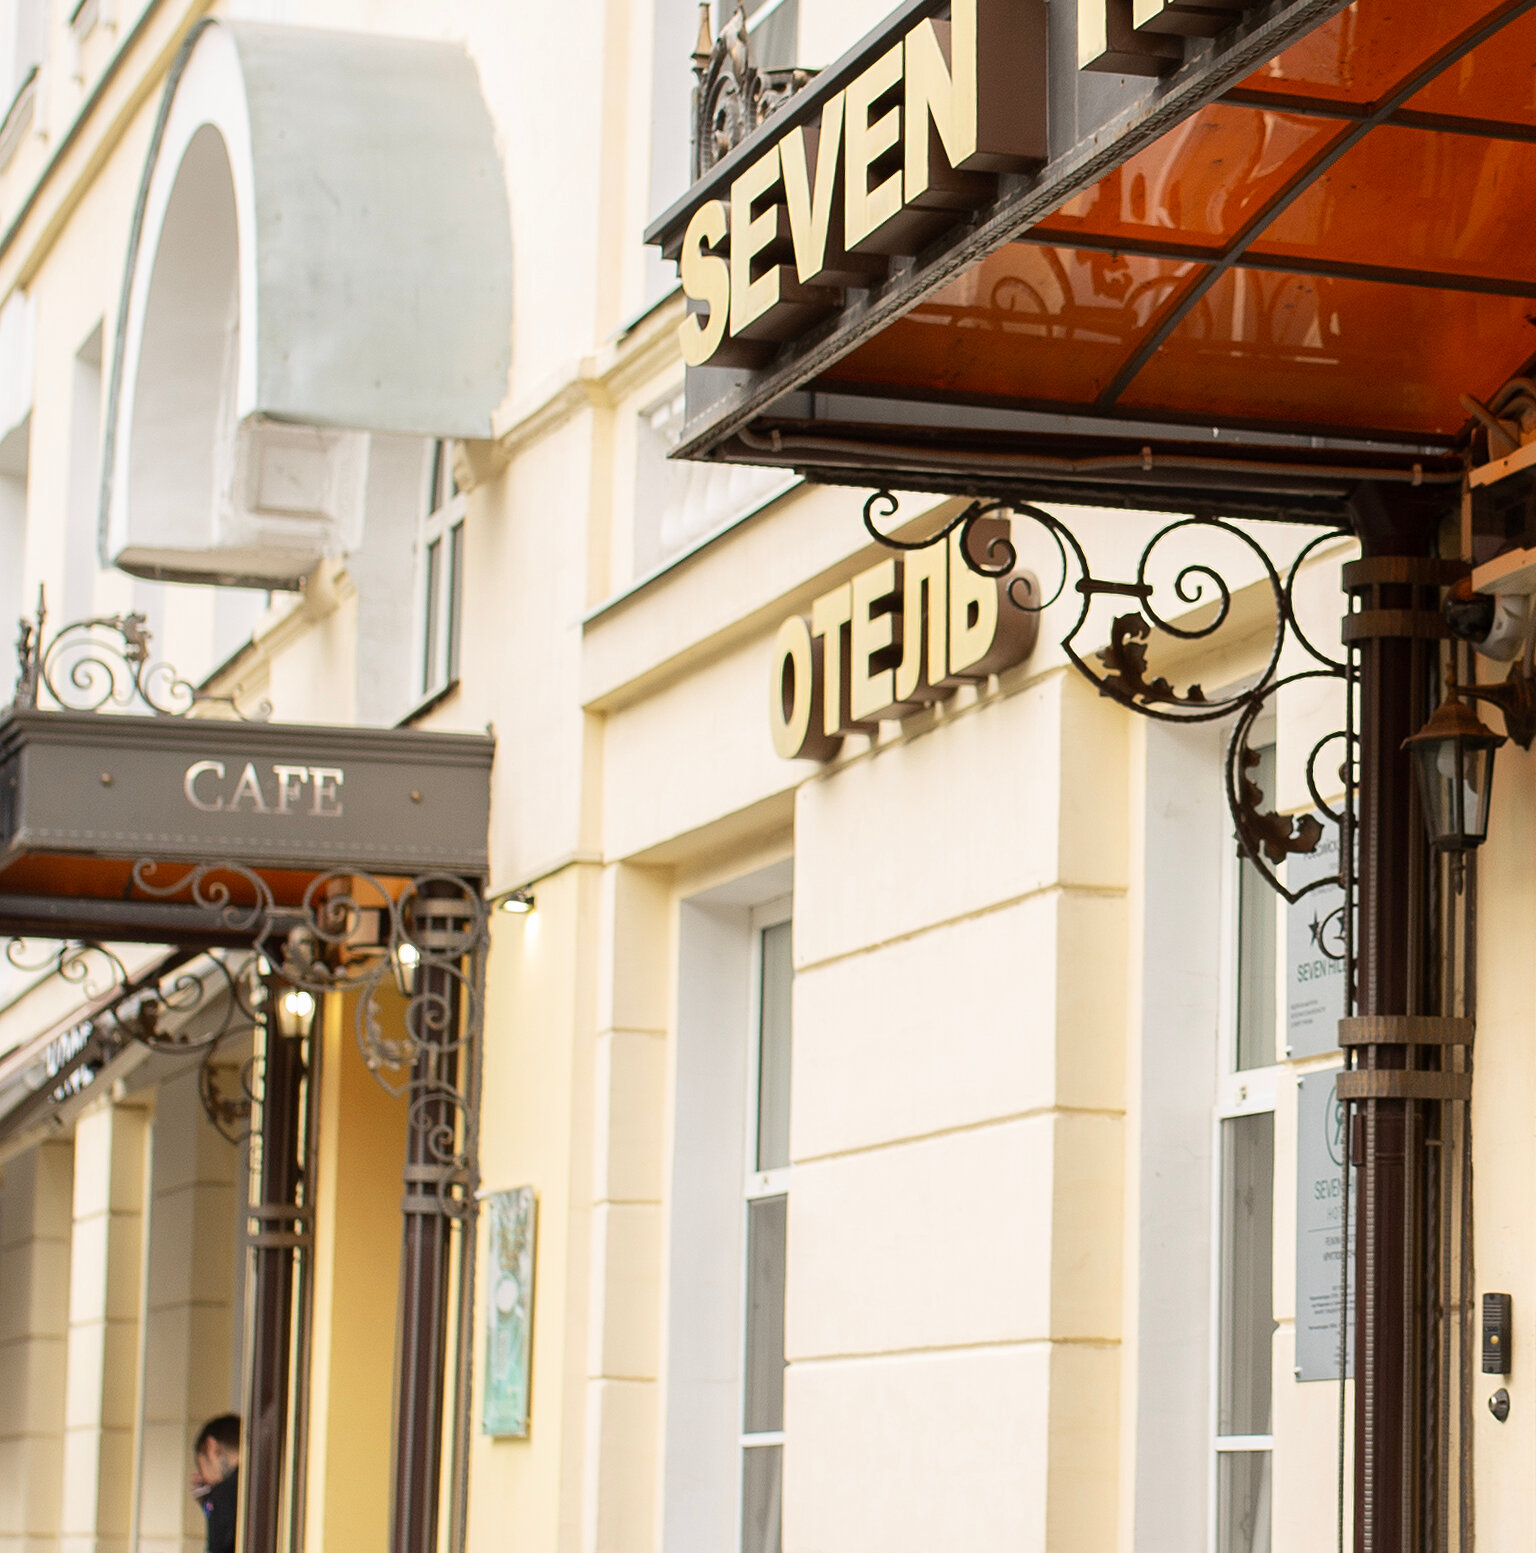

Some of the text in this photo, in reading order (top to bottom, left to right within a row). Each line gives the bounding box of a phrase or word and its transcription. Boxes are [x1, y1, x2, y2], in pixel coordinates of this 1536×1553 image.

[769, 522, 999, 760] ОТЕЛЬ
[183, 759, 345, 818] CAFE
[1298, 960, 1327, 982] SEVEN
